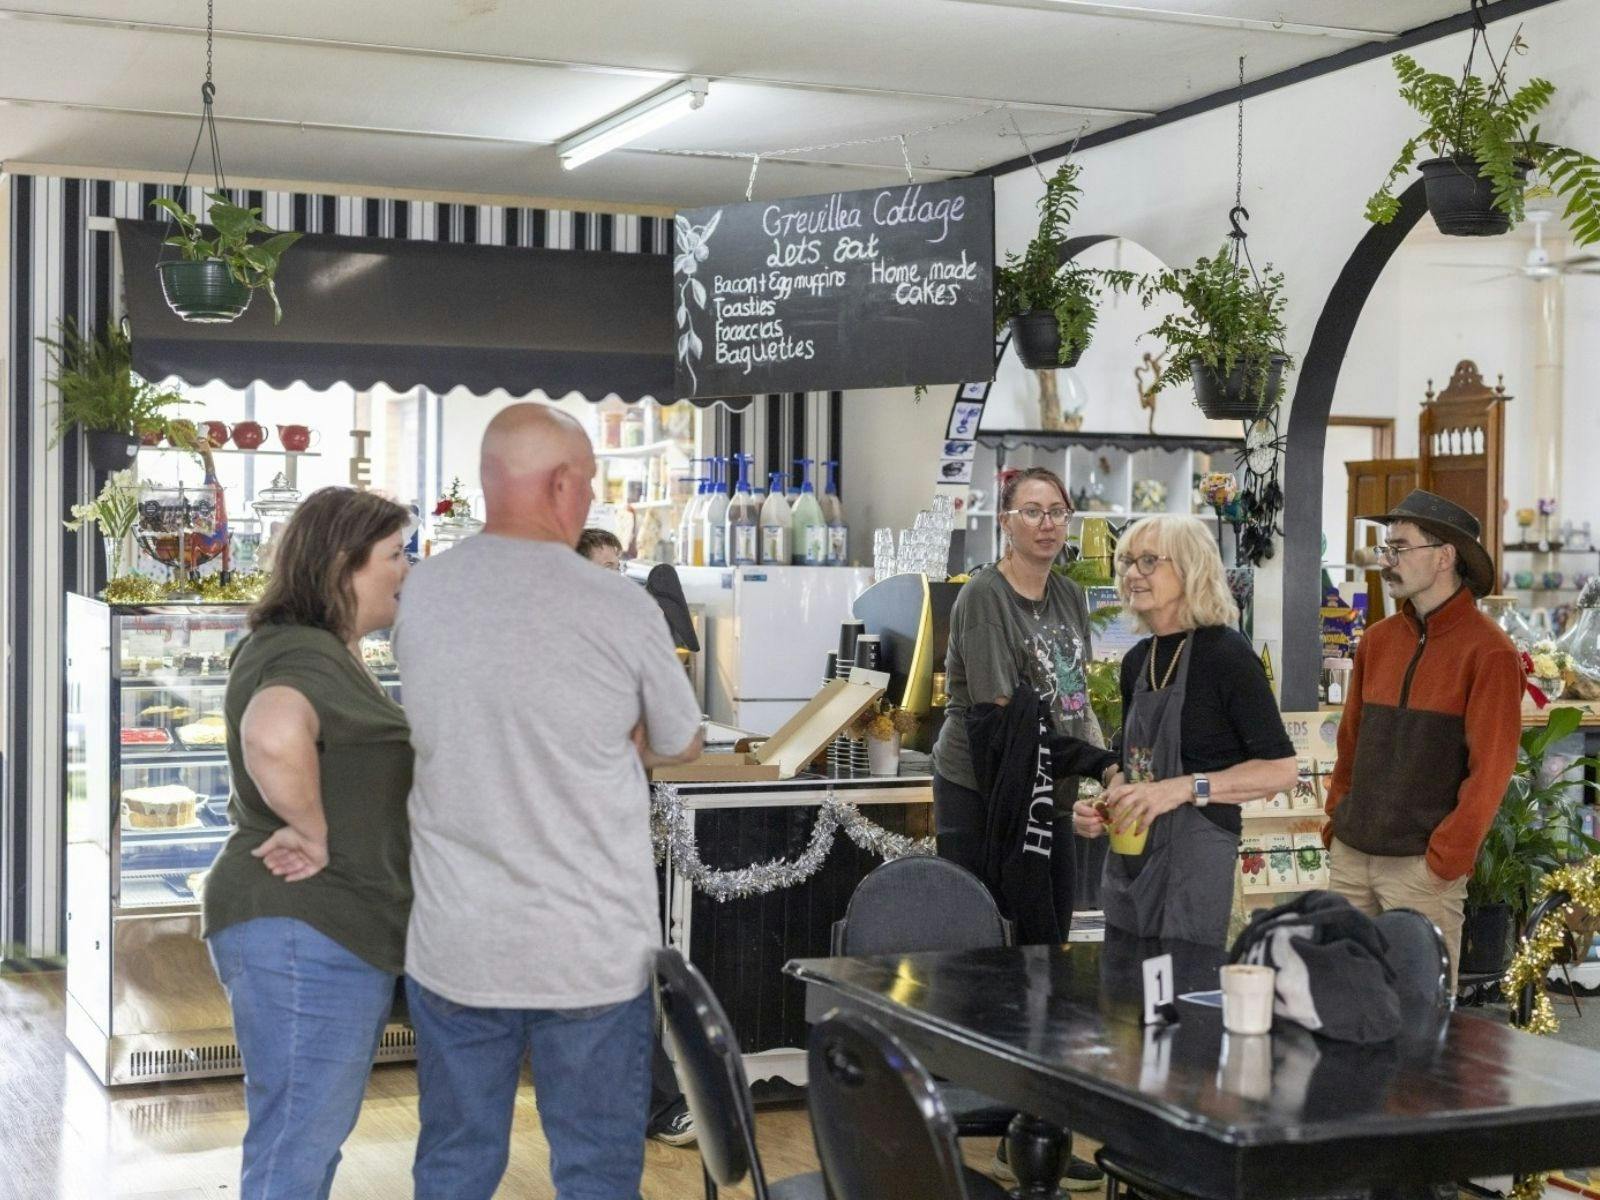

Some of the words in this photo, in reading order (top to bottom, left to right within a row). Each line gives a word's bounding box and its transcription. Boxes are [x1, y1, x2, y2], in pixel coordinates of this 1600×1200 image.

[763, 193, 862, 237] Grevillea
[873, 185, 965, 243] Cottage
[766, 235, 822, 267] Lets
[871, 256, 921, 284] Home
[929, 249, 977, 280] made
[714, 275, 758, 294] Bacon
[768, 270, 793, 300] Egg
[793, 265, 847, 297] muffins
[713, 296, 777, 322] Toasties
[715, 319, 784, 341] Focaccias
[715, 335, 815, 375] Baguettes
[1156, 969, 1164, 1001] 1
